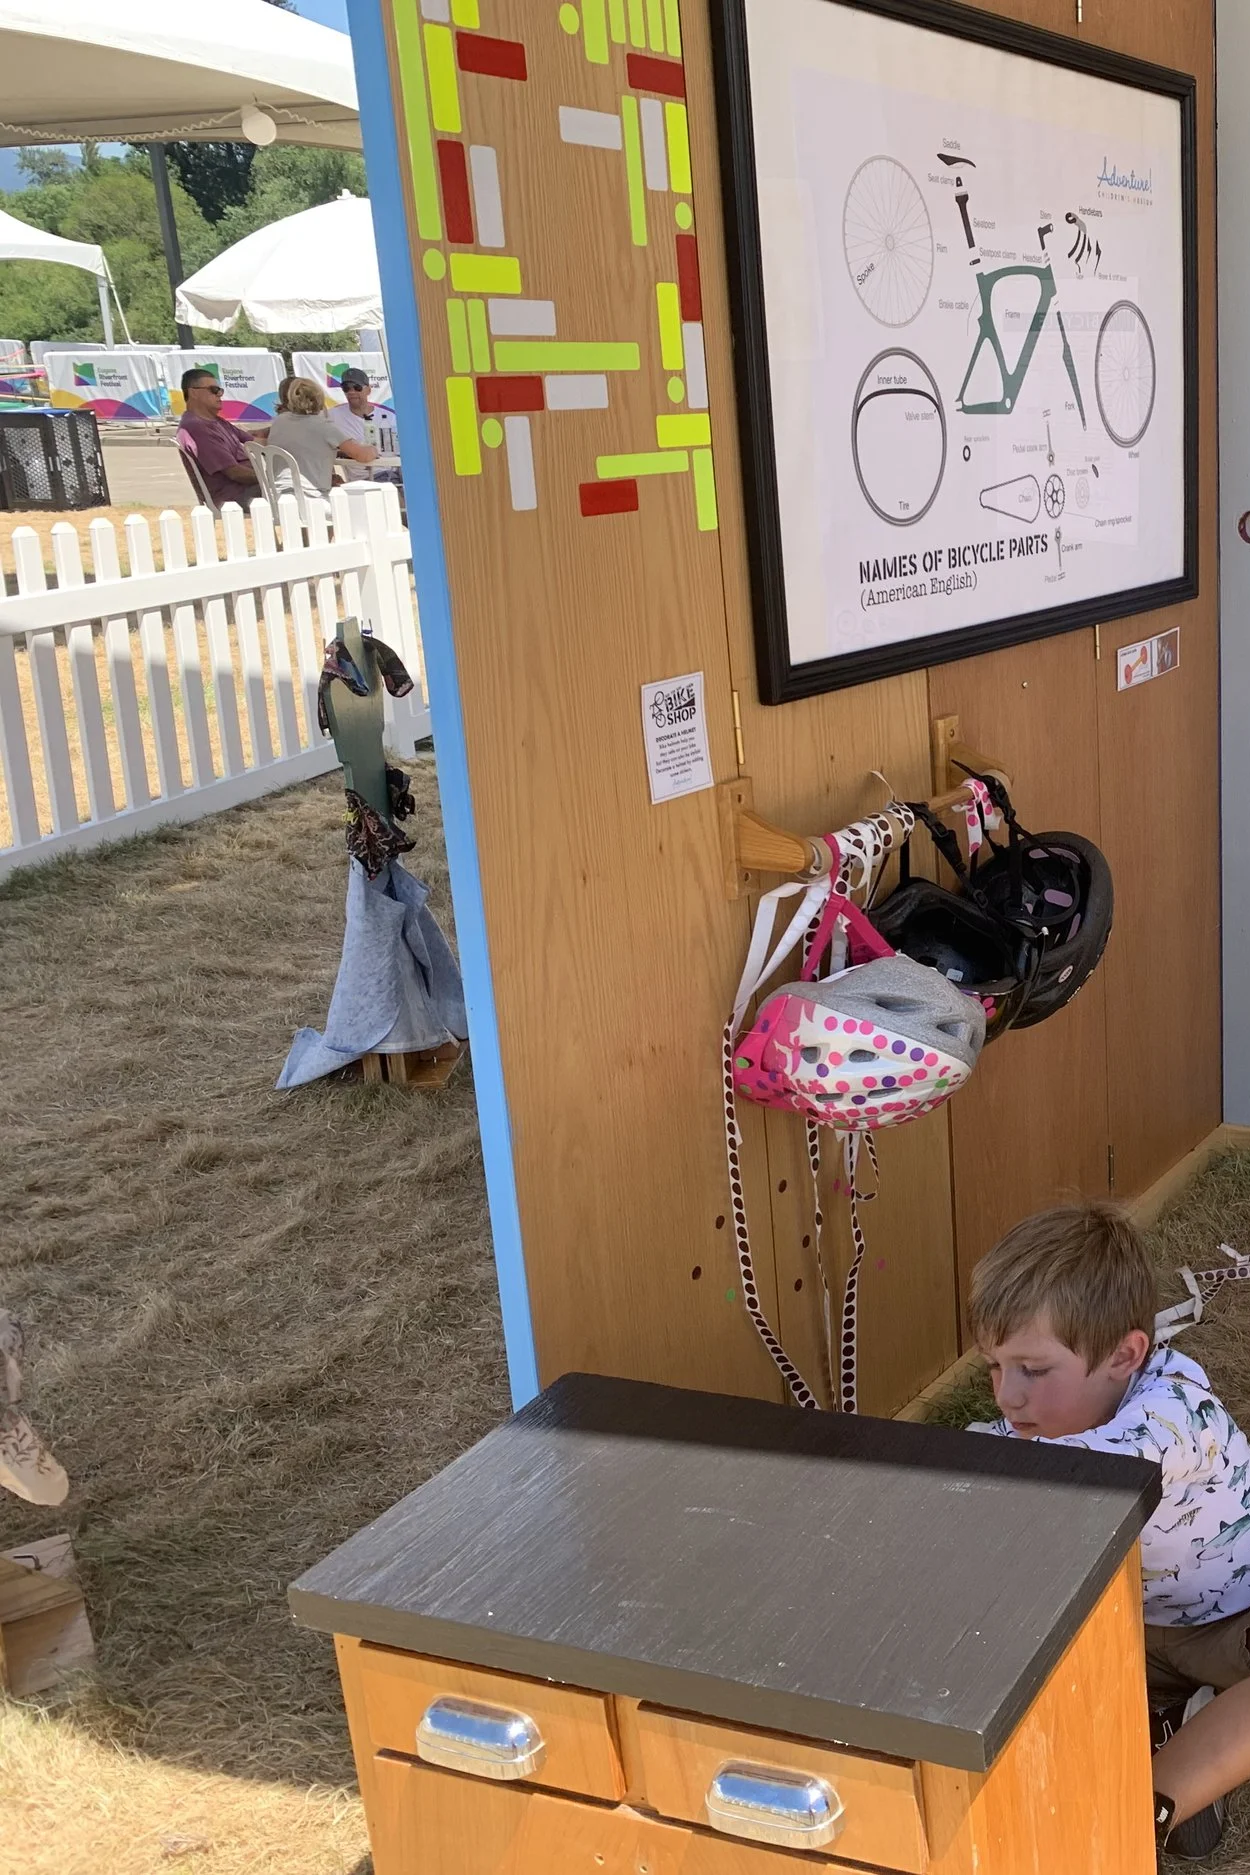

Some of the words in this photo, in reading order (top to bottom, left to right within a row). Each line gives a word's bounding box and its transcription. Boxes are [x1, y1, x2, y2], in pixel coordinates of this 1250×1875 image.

[942, 138, 961, 151] Saddle
[1097, 156, 1152, 194] Adventure!
[857, 262, 875, 285] Spoke
[222, 368, 243, 376] Eugene
[877, 375, 893, 384] Inner
[894, 376, 907, 384] tube
[100, 380, 122, 388] Festival
[905, 411, 920, 421] Valve
[898, 501, 910, 511] Tire
[859, 553, 918, 584] NAMES
[922, 550, 943, 572] OF
[948, 540, 1005, 569] BICYCLE
[1009, 533, 1048, 559] PARTS
[861, 583, 927, 611] (American
[930, 570, 978, 596] English)
[664, 688, 695, 713] BIKE
[667, 707, 697, 726] SHOP
